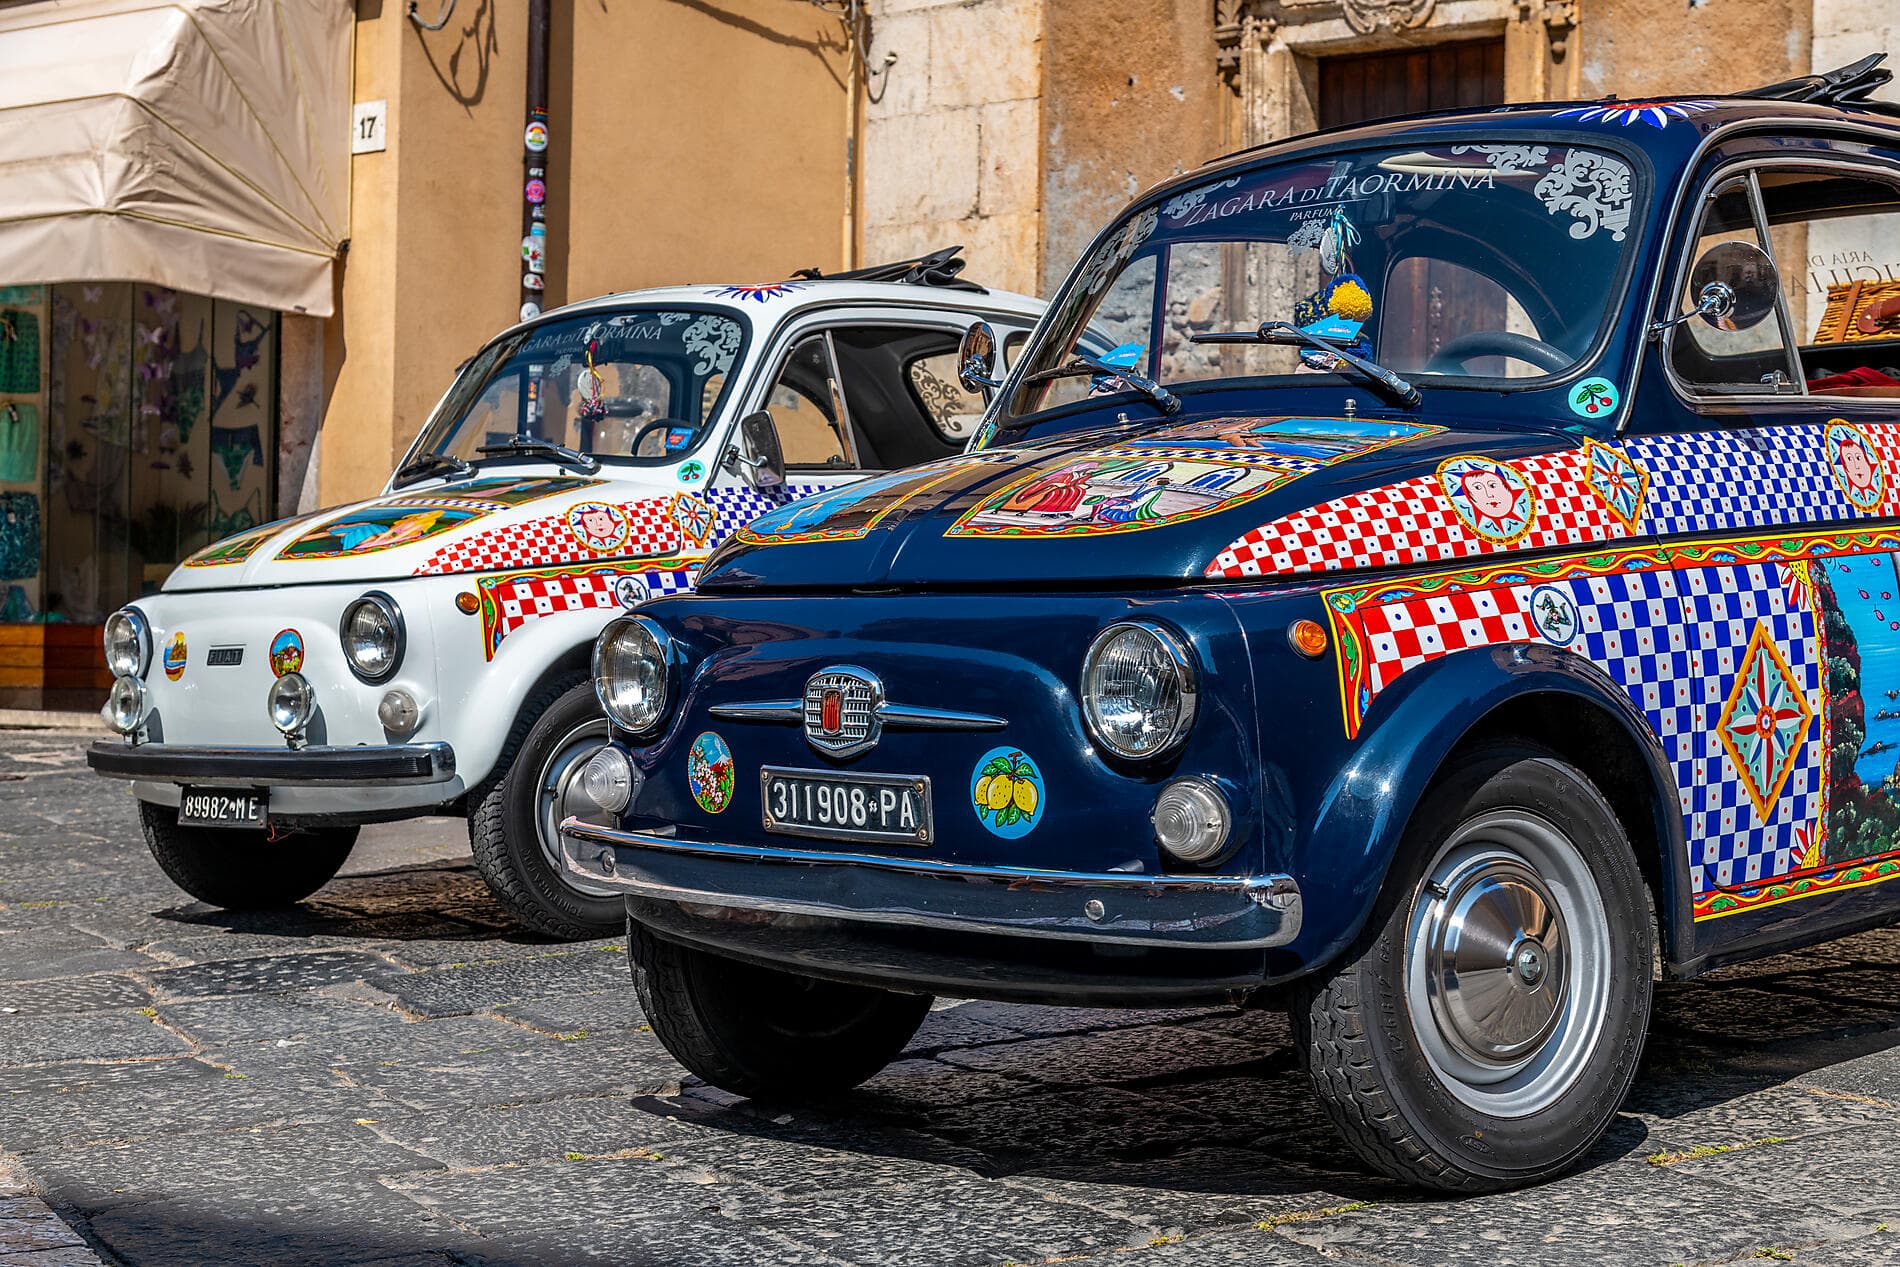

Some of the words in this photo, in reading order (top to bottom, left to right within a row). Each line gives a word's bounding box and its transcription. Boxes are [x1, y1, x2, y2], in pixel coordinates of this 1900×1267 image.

[360, 115, 377, 139] 17
[1184, 186, 1294, 227] ZAGARA
[1299, 187, 1326, 202] DI
[1325, 169, 1496, 199] TAORMINA
[208, 650, 241, 663] FIAT
[185, 795, 229, 819] 89982
[235, 796, 259, 820] ME
[773, 782, 867, 828] 311908
[880, 789, 915, 829] PA
